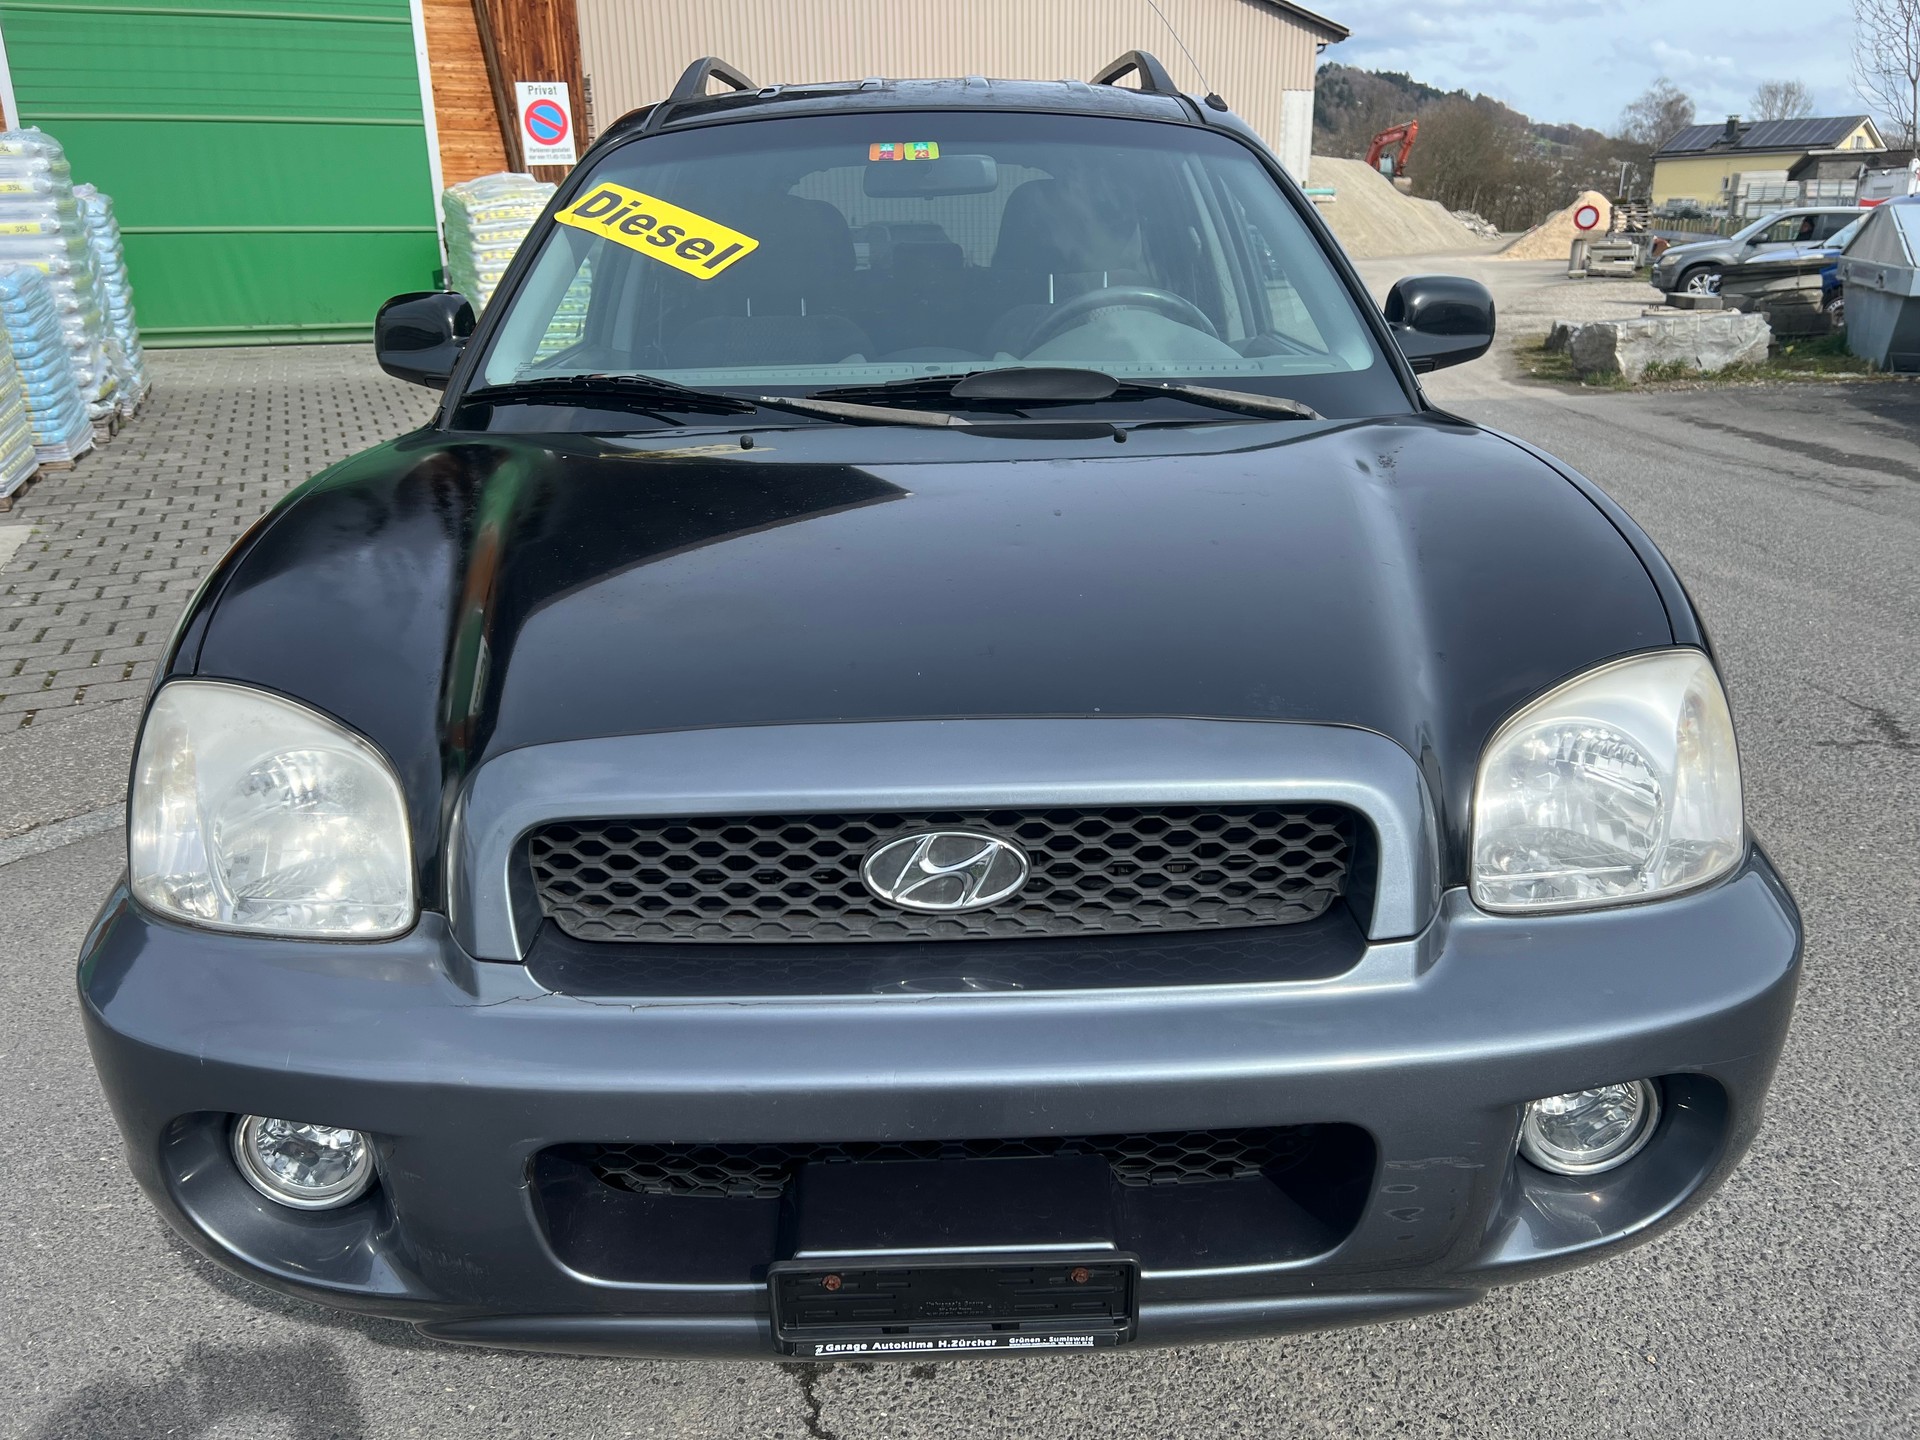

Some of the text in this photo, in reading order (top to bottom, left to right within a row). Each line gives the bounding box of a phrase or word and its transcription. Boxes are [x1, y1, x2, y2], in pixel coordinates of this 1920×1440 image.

[527, 85, 558, 96] Privat
[572, 190, 744, 269] Diesel
[825, 1343, 868, 1352] Garage
[872, 1341, 933, 1350] Autoklima
[938, 1339, 997, 1348] H.Zürcher
